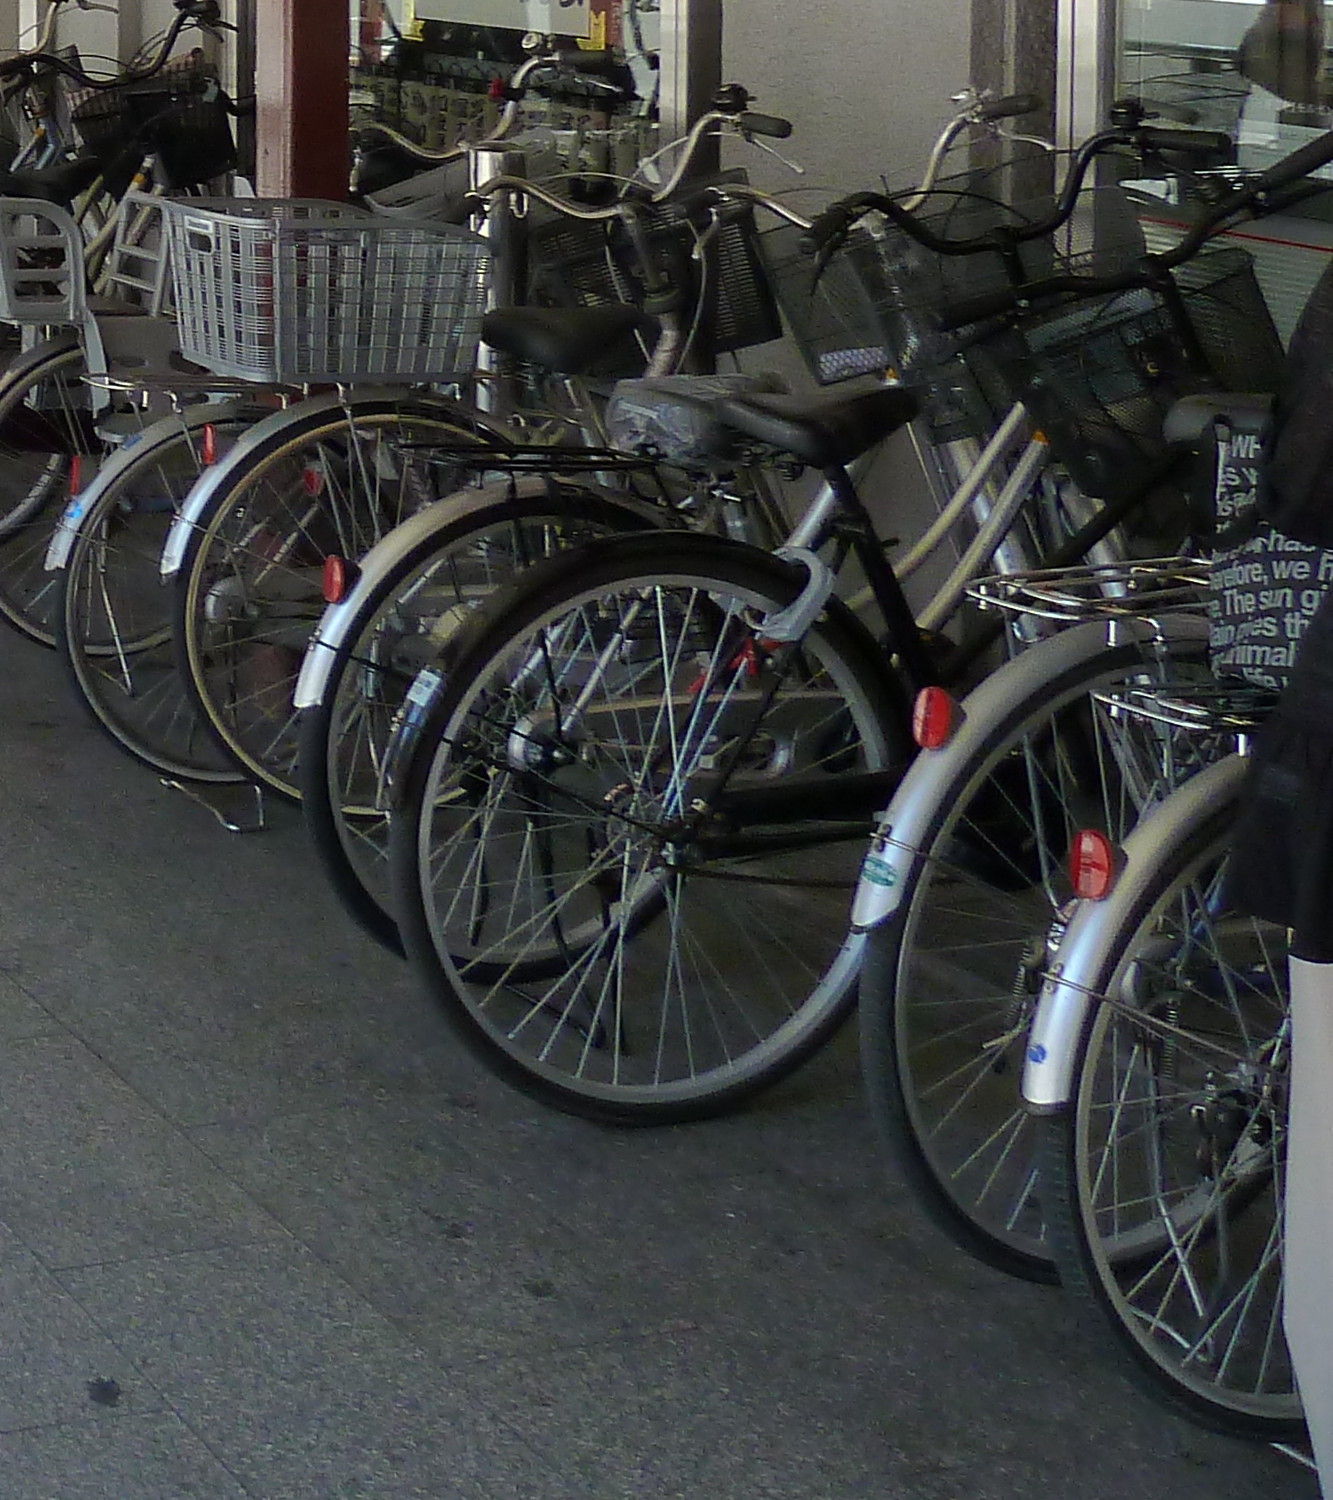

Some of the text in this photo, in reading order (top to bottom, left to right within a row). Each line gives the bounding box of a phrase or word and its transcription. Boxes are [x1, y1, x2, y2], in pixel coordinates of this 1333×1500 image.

[1271, 560, 1310, 580] we
[1223, 589, 1255, 615] The
[1259, 587, 1292, 611] sun
